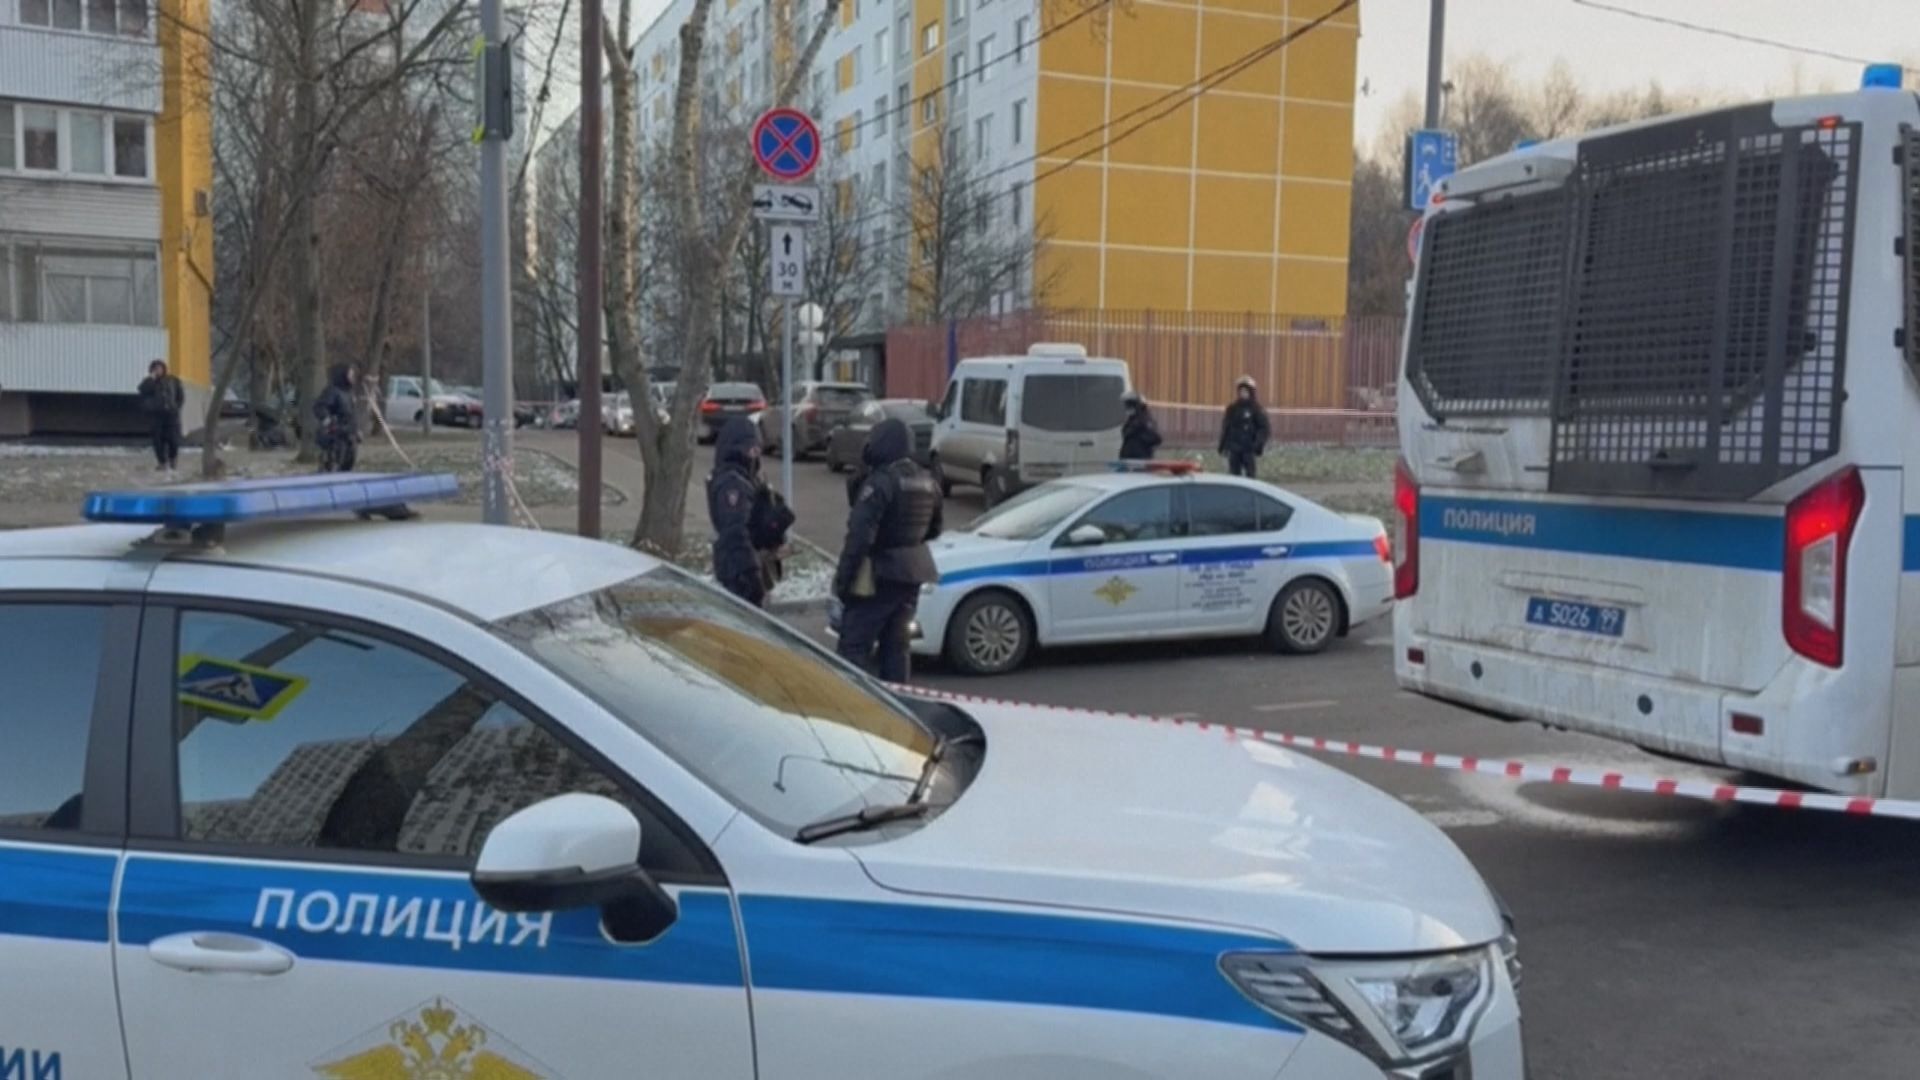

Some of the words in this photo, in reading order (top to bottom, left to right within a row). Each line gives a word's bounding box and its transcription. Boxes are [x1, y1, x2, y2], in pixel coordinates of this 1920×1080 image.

[778, 262, 798, 277] 30
[1443, 507, 1536, 536] ПОЛИЦИЯ
[1550, 603, 1591, 628] 5026
[1600, 608, 1619, 625] 99
[251, 886, 553, 951] ПОЛИЦИЯ
